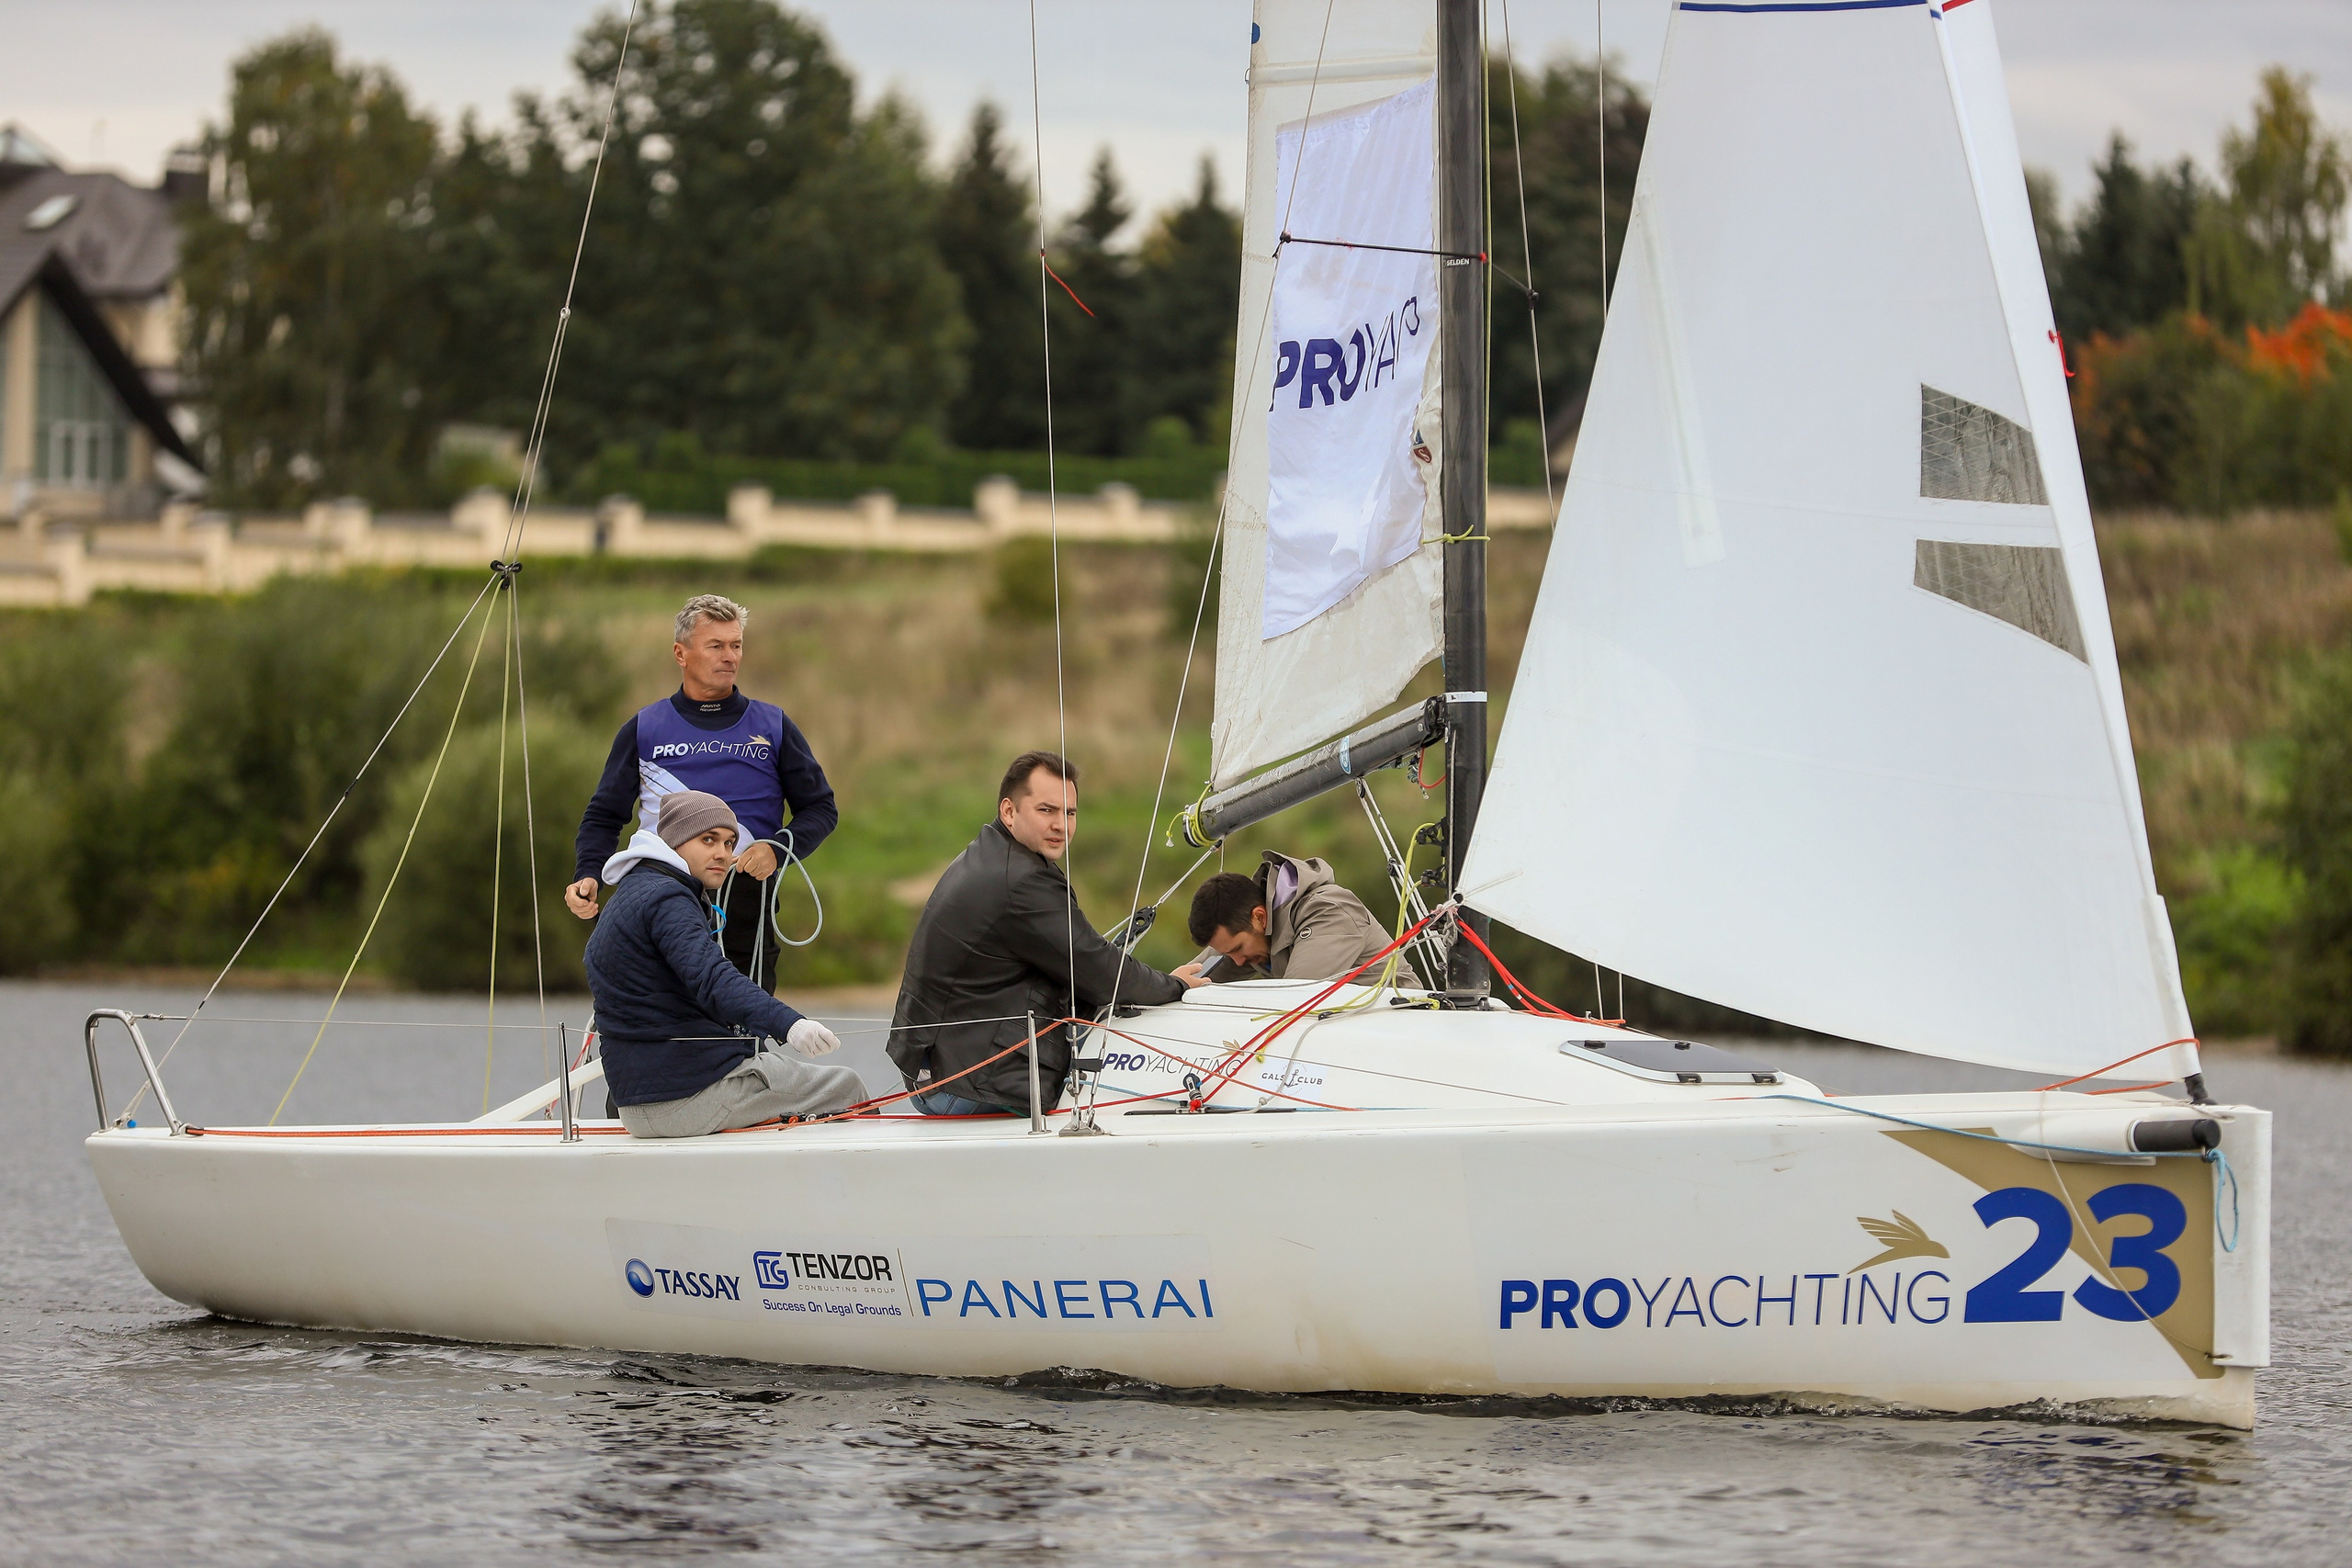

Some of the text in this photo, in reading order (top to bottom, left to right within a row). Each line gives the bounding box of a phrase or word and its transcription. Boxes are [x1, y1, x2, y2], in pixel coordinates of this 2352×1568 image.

[652, 740, 770, 761] PROYACHTING
[1297, 1076, 1323, 1085] CLUB
[786, 1252, 893, 1281] TENZOR
[1499, 1183, 2188, 1330] PROYACHTING 23
[654, 1268, 741, 1301] TASSAY
[797, 1284, 858, 1292] CONSULTING
[763, 1299, 902, 1316] Success On Legal Grounds
[916, 1279, 1214, 1318] PANERAI
